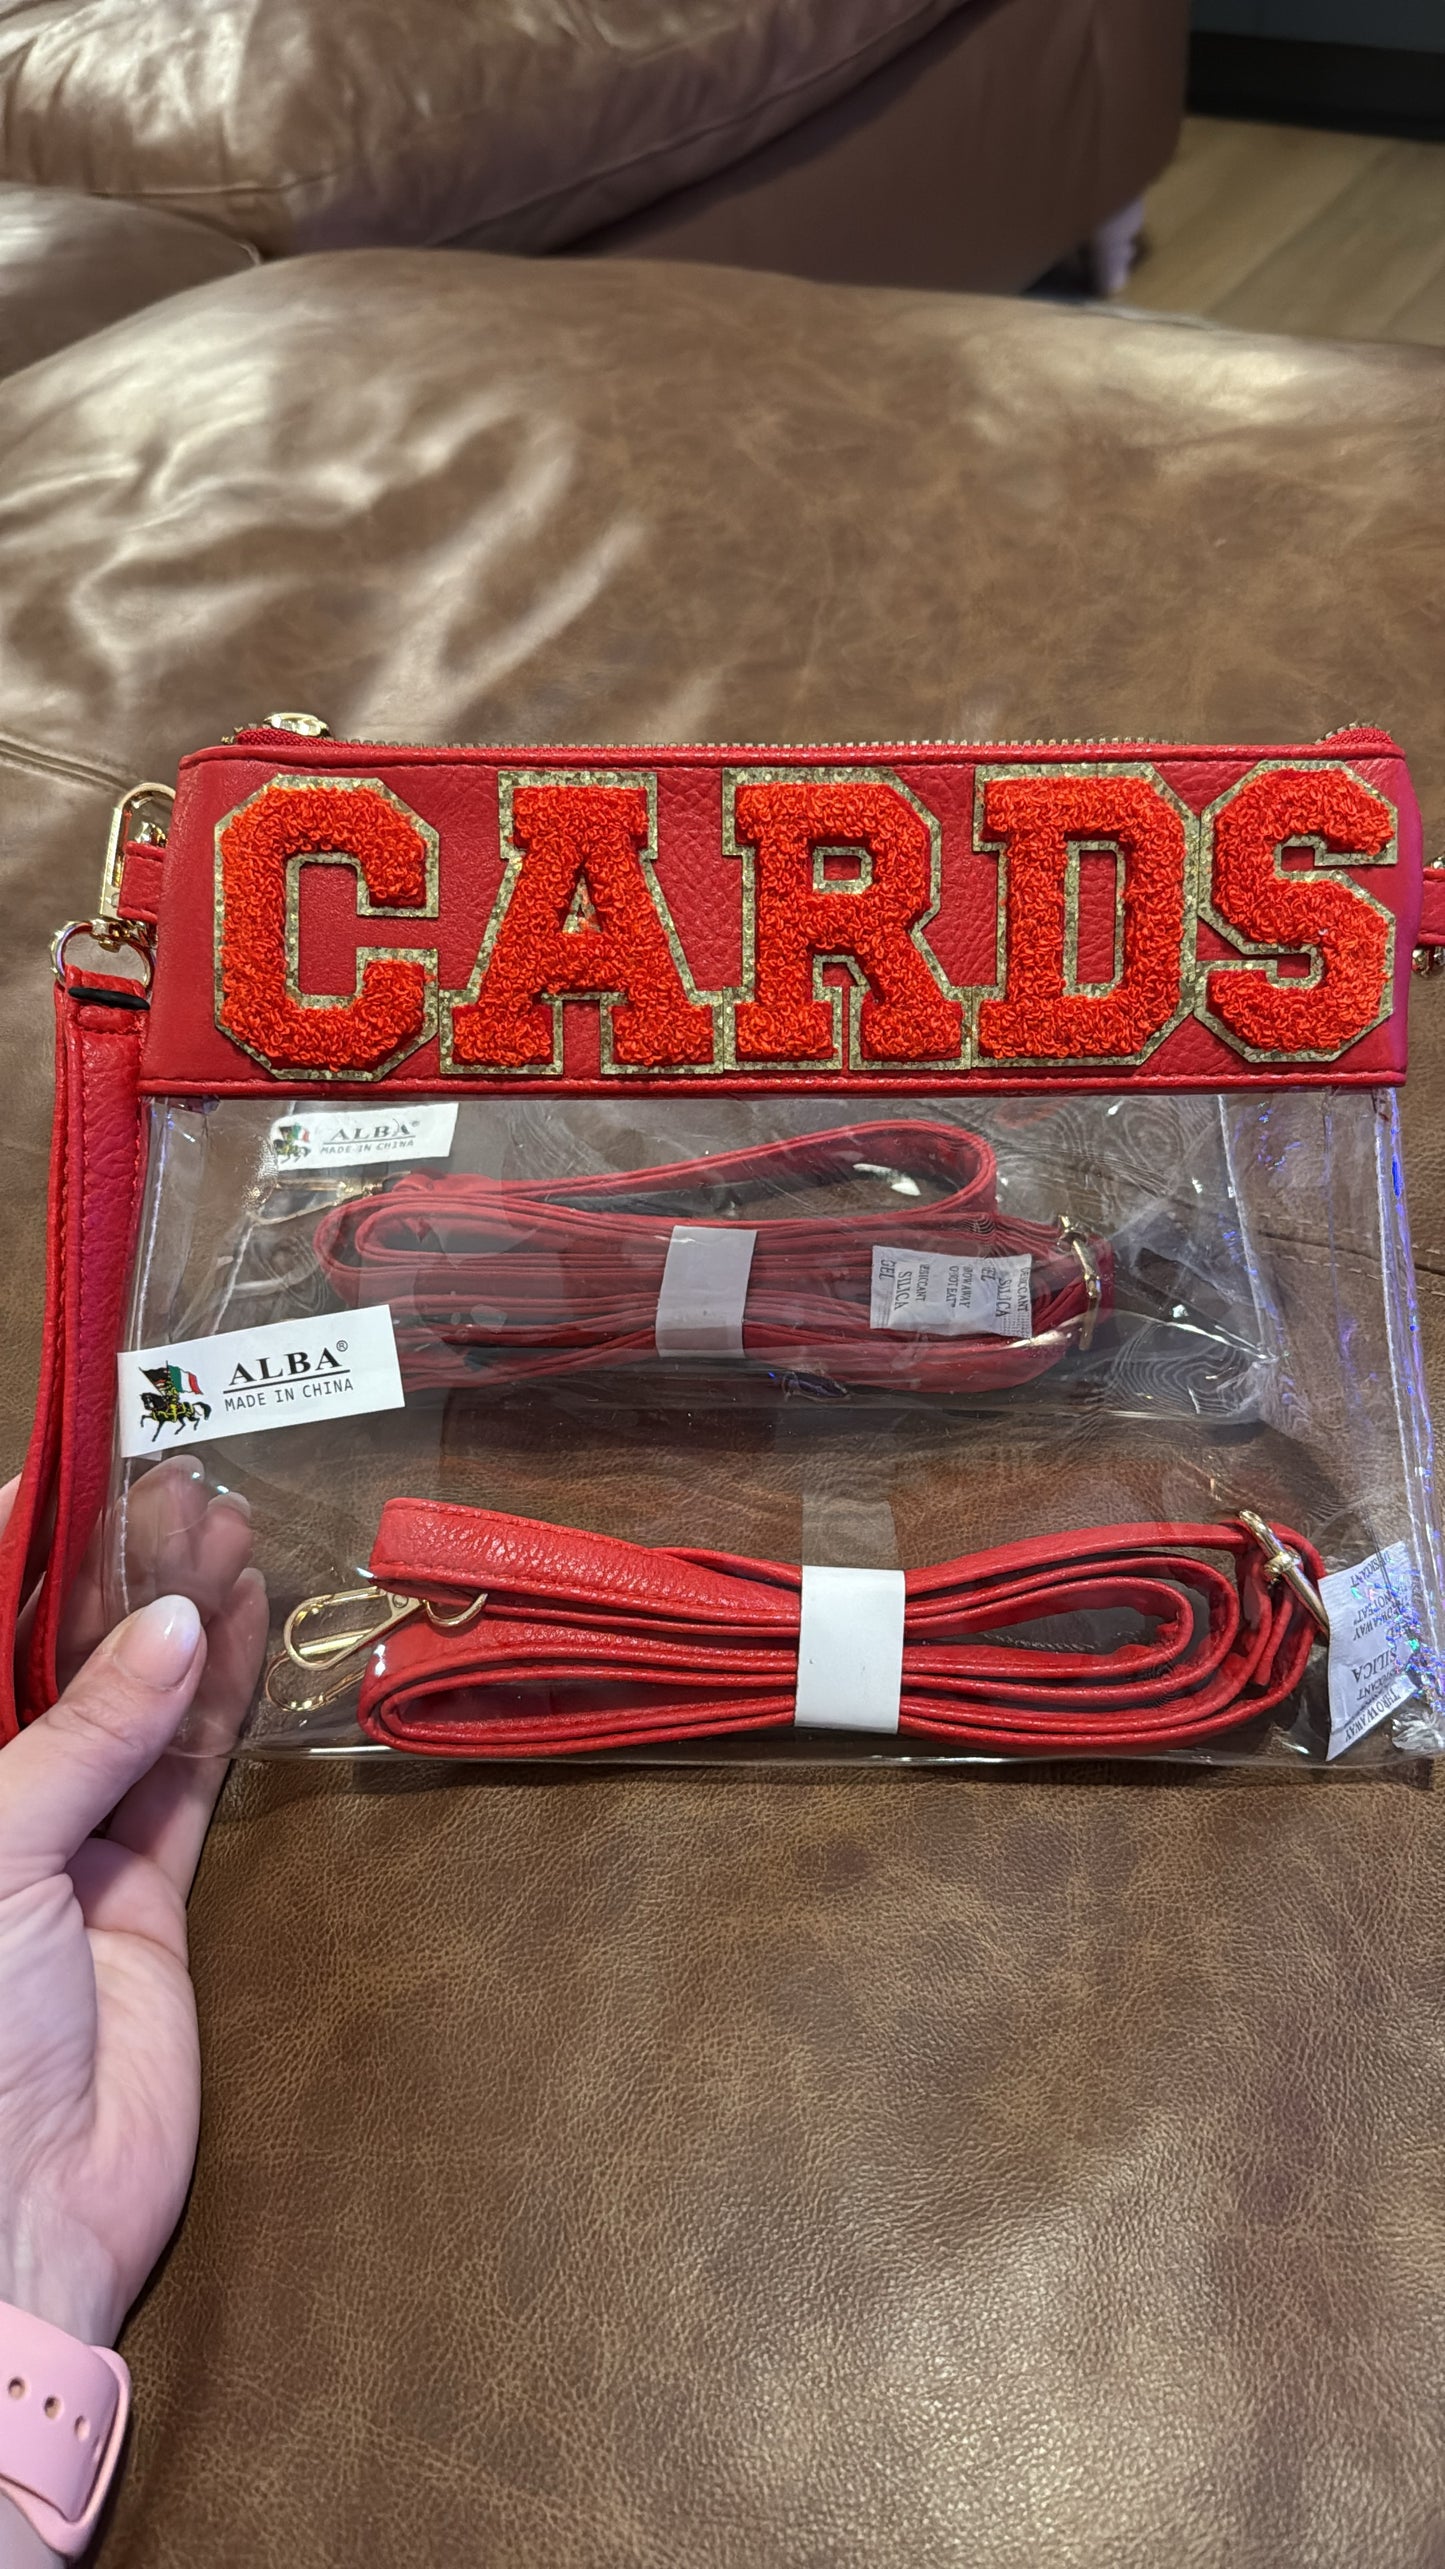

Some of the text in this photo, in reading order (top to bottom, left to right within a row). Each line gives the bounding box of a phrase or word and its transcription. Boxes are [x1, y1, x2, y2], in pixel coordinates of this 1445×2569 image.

[214, 759, 1397, 1079] CARDS
[320, 1139, 414, 1154] MADE IN CHINA
[879, 1260, 897, 1280] GEL
[893, 1271, 912, 1311] SILICA
[995, 1277, 1013, 1317] SILICA
[225, 1378, 354, 1412] MADE IN CHINA
[1352, 1646, 1398, 1684] SILICA
